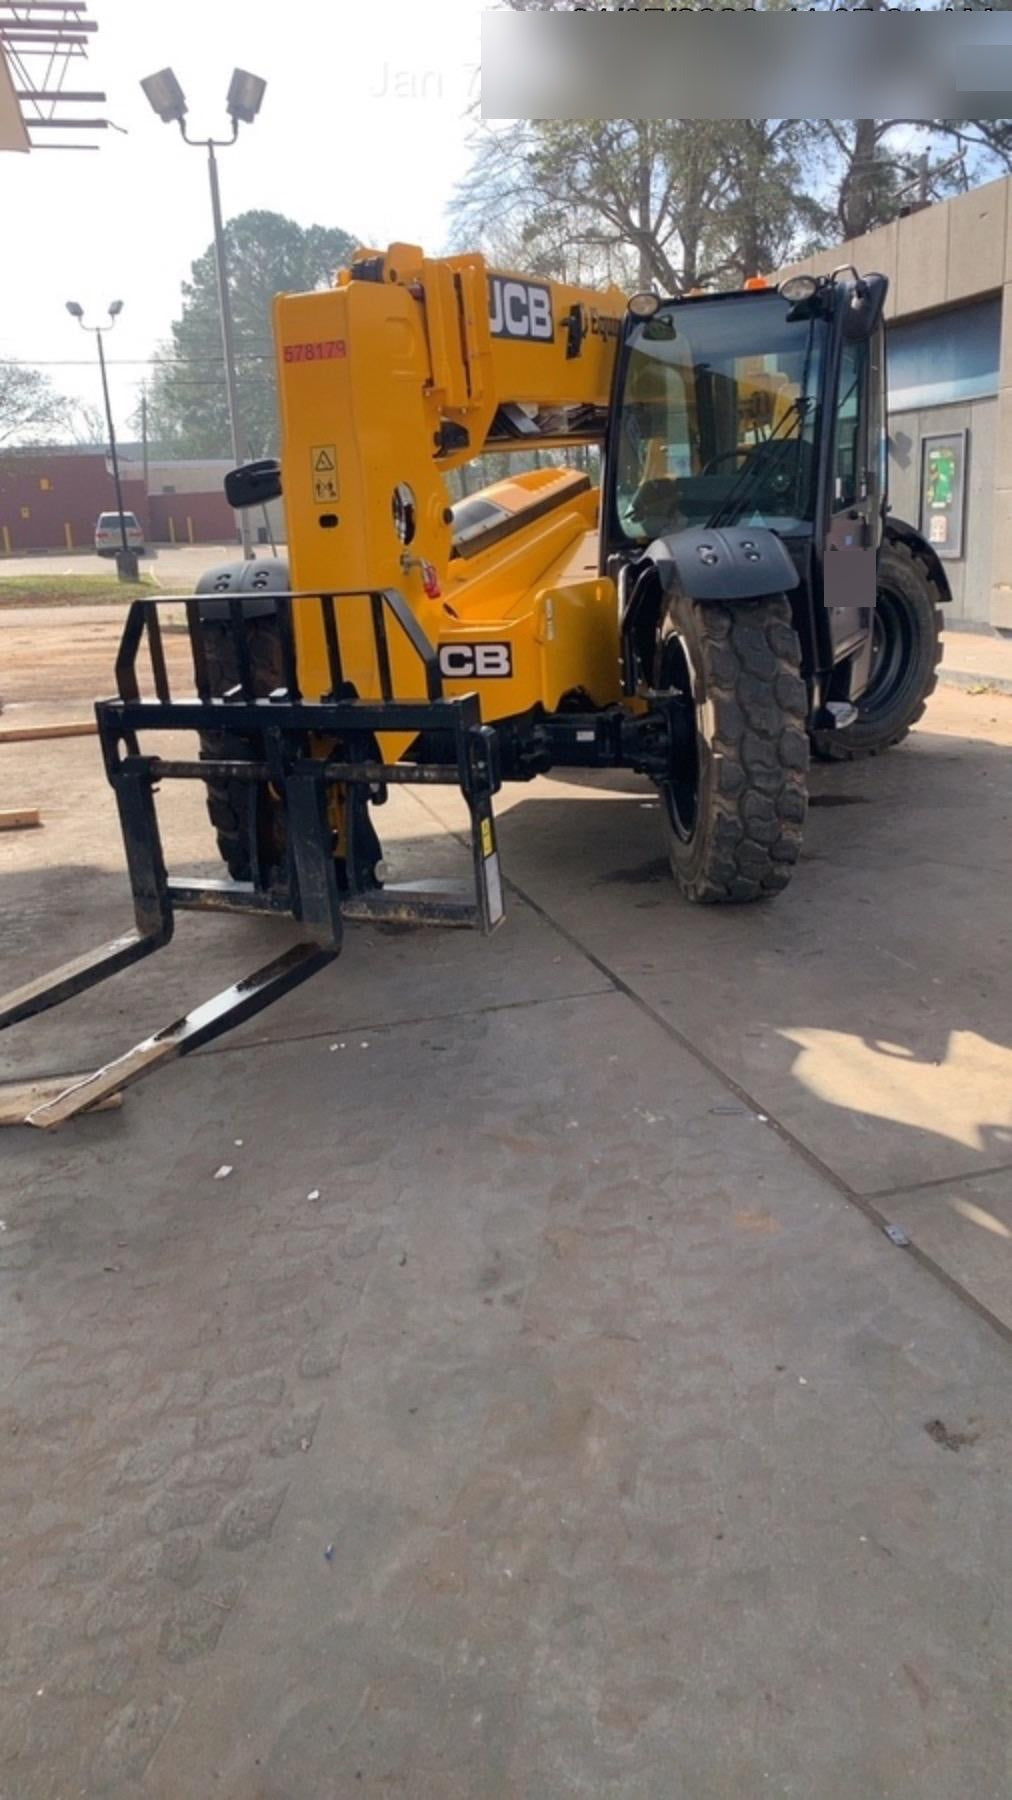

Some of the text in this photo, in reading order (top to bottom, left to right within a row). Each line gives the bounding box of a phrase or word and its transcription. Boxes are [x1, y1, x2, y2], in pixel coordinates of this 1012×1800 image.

[489, 280, 553, 338] JCB
[283, 339, 346, 363] 578179
[439, 644, 511, 676] CB
